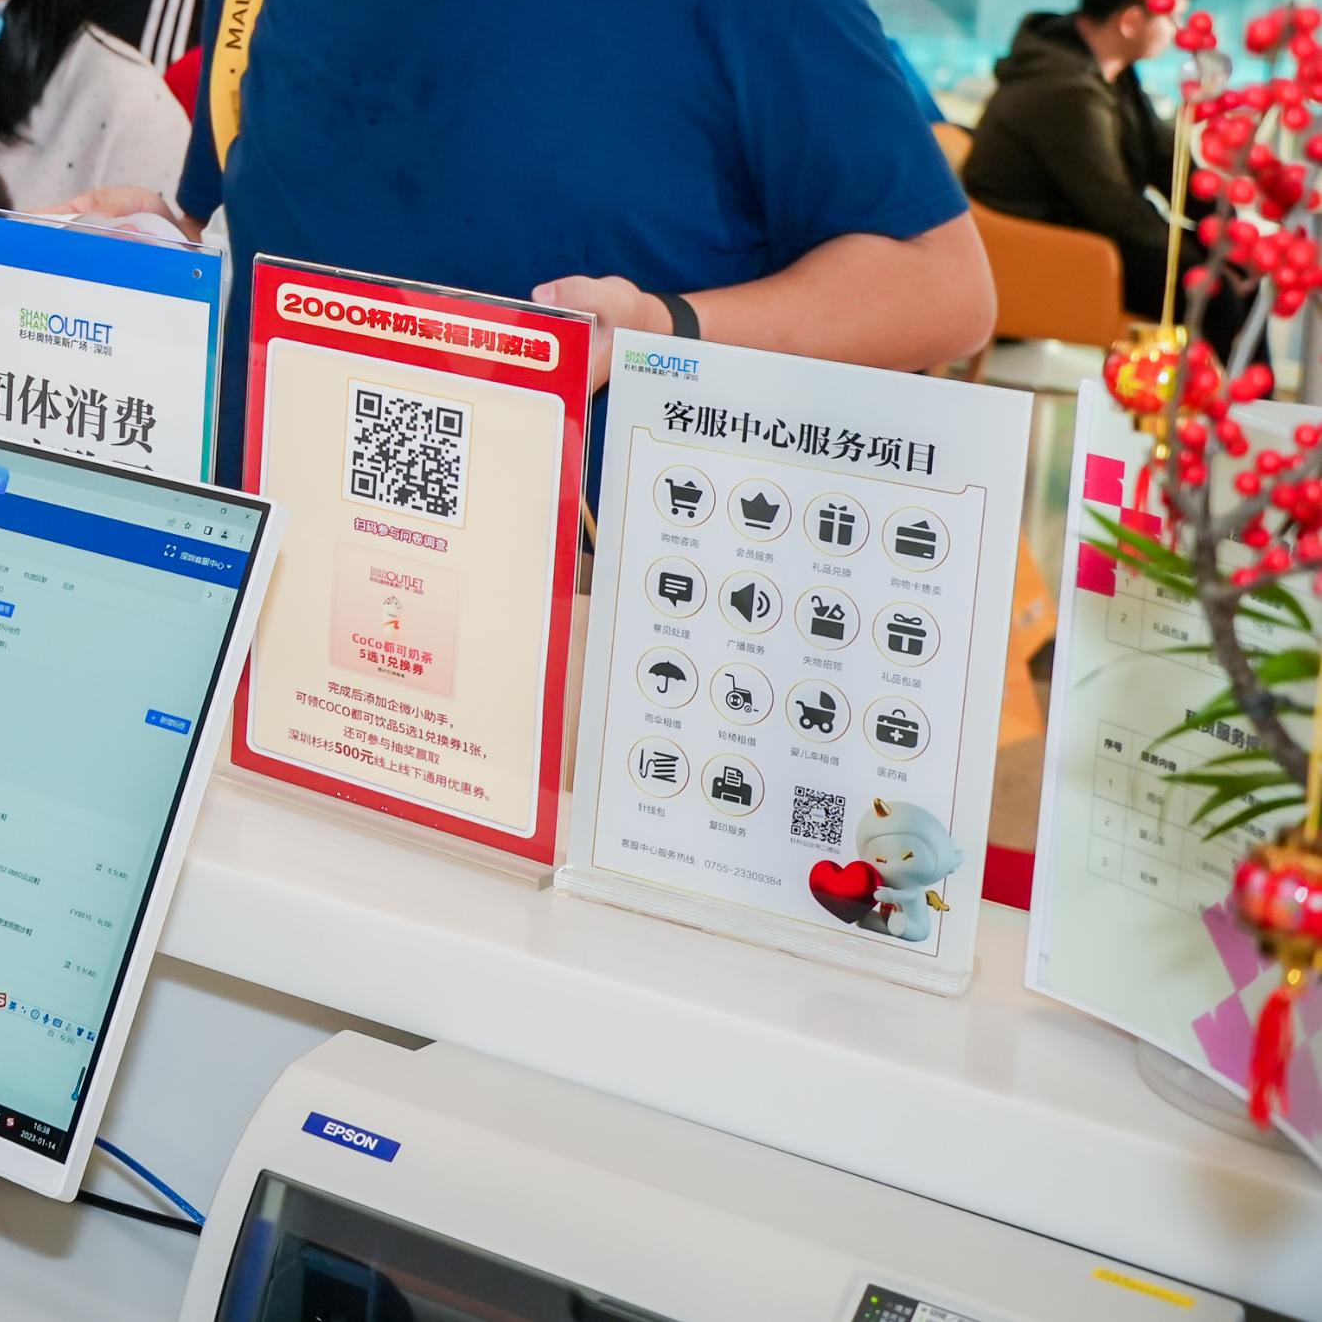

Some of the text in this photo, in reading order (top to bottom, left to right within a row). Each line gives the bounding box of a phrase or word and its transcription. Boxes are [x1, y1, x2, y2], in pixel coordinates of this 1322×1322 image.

[19, 316, 48, 331] SHAN
[20, 308, 49, 322] SHAN
[48, 314, 113, 345] OUTLET
[283, 293, 551, 363] 2000杯奶茶福利放送
[647, 353, 699, 373] OUTLET
[663, 400, 936, 475] 客服中心服务项目
[353, 516, 449, 553] 扫码参与问卷调查
[660, 531, 700, 549] 购物咨询
[735, 546, 774, 564] 会员服务
[812, 561, 852, 579] 礼品兑换
[386, 570, 424, 590] OUTLET
[890, 576, 942, 596] 购物卡售卖
[653, 622, 691, 641] 意见处理
[352, 633, 433, 665] CoCo都可奶茶
[726, 638, 766, 656] 广播服务
[359, 648, 424, 676] 5选1兑换券
[881, 671, 923, 689] 礼品包装
[644, 712, 682, 730] 雨伞租借
[343, 726, 440, 765] 还可参与抽奖赢取
[717, 729, 757, 748] 轮椅租借
[789, 746, 840, 766] 婴儿车租借
[877, 766, 908, 783] 医药箱
[638, 803, 666, 818] 针线包
[708, 819, 747, 838] 复印服务
[704, 859, 782, 887] 0755-23309384
[32, 1120, 51, 1136] 16:38
[321, 1120, 378, 1151] EPSON
[19, 1128, 57, 1152] 2023-01-14
